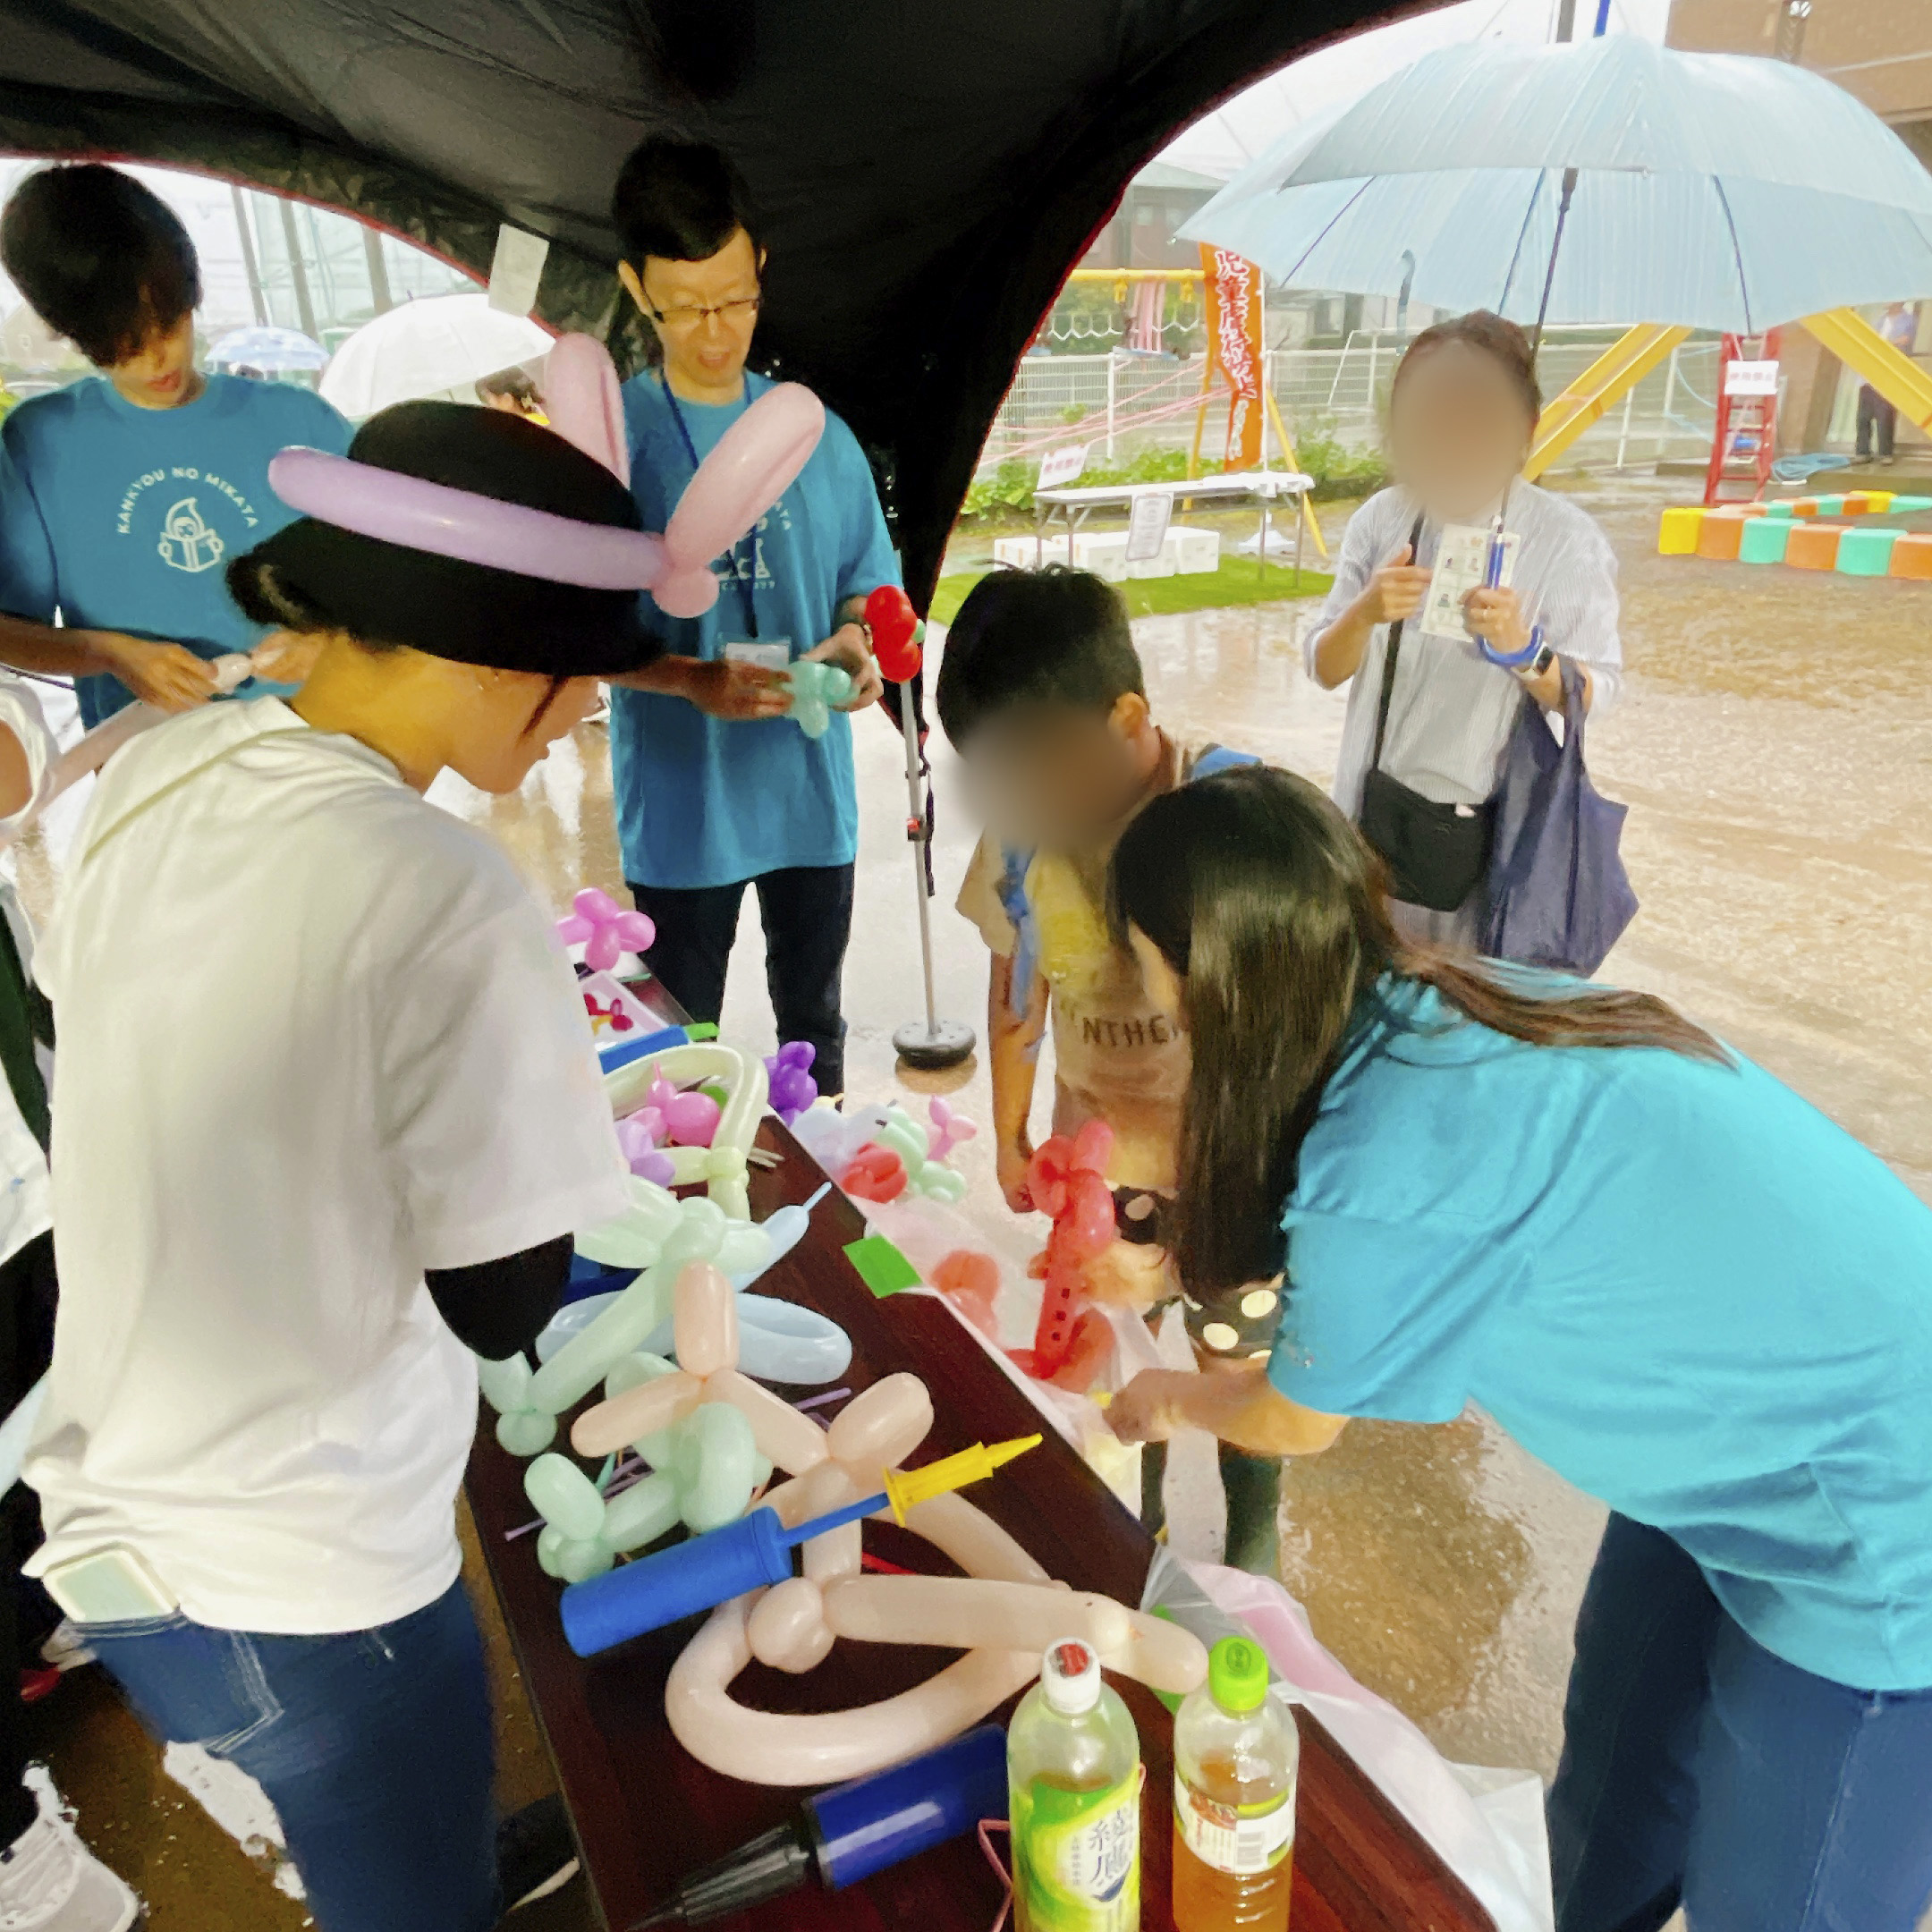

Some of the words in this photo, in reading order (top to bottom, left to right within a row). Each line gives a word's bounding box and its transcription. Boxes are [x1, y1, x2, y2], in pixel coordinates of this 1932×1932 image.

[116, 469, 165, 535] KANKYOU
[171, 466, 199, 480] NO
[204, 472, 259, 529] MIKATA
[1071, 1011, 1180, 1048] NTHE
